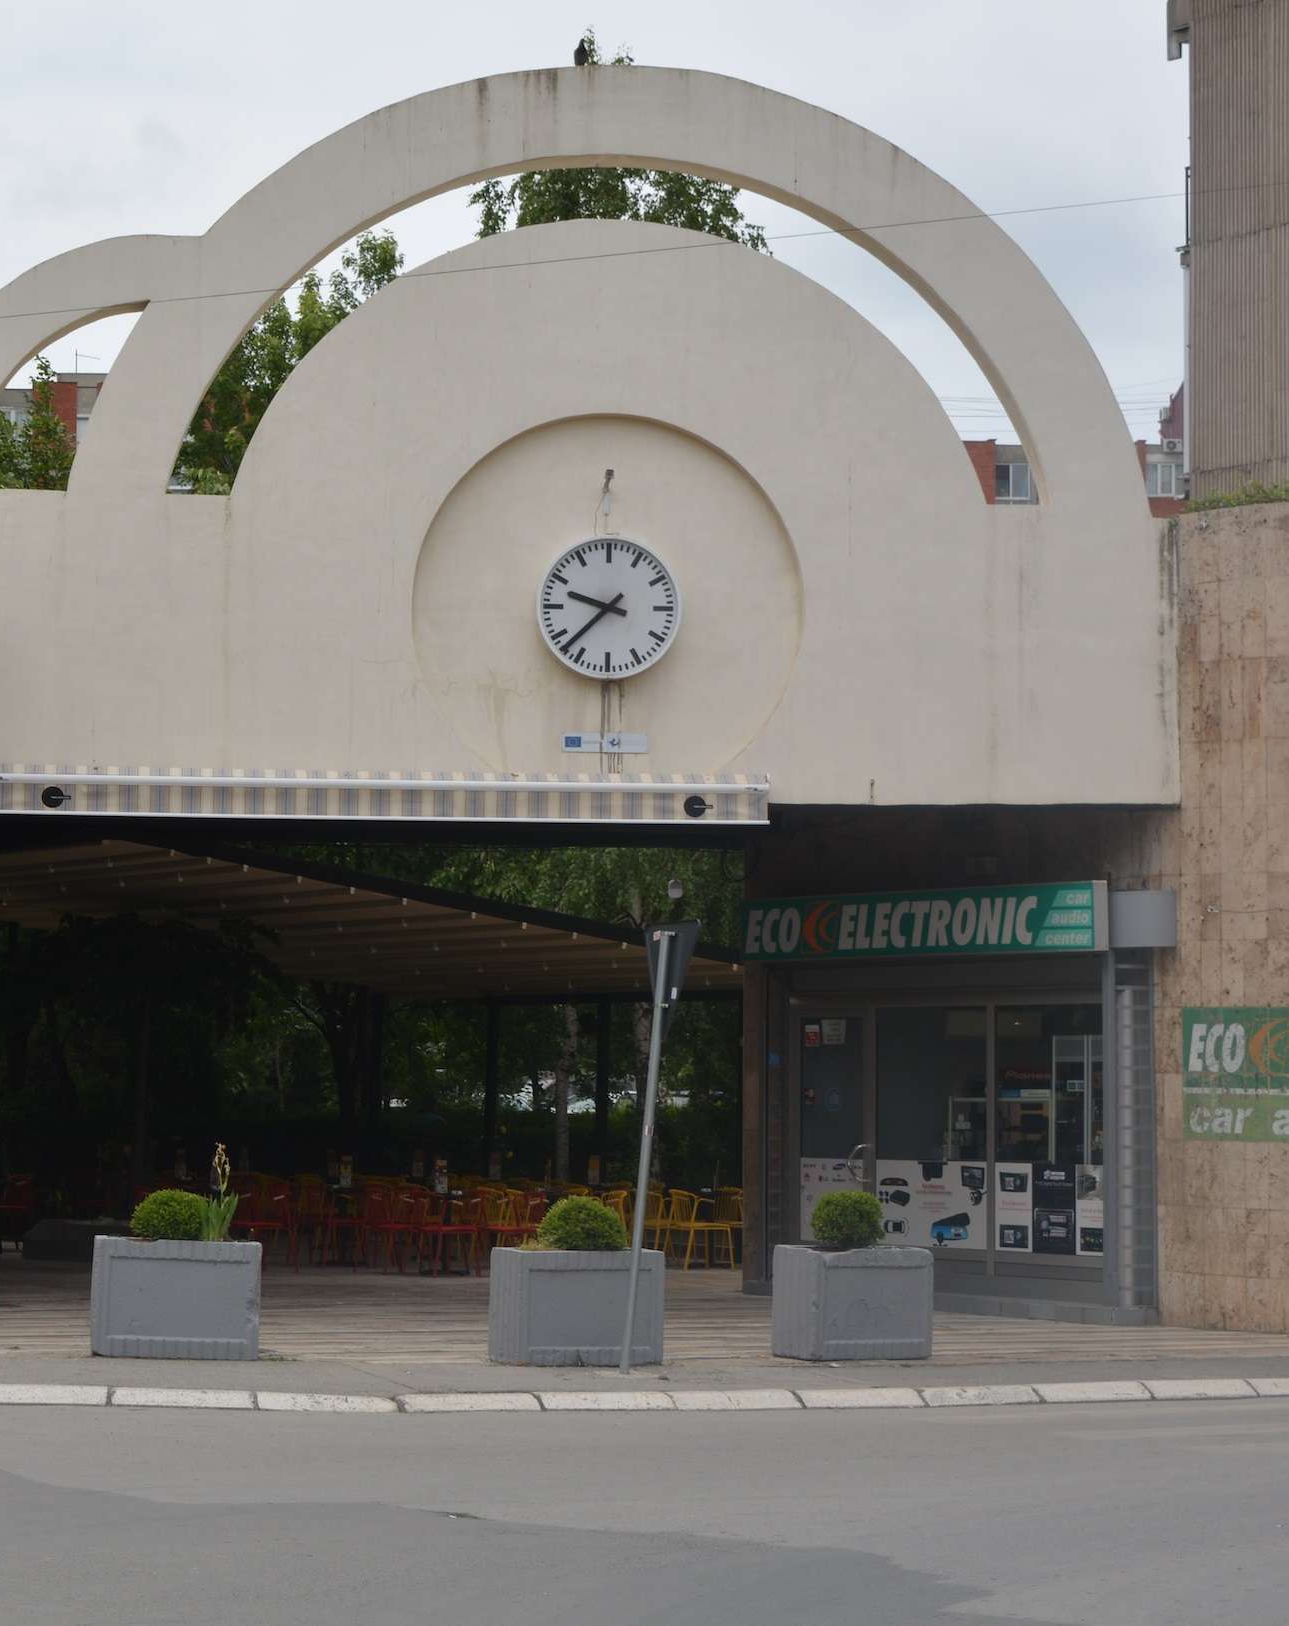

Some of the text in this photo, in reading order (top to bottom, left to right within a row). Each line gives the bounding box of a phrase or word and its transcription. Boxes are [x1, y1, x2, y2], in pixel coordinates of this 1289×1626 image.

[1065, 893, 1089, 906] car
[745, 895, 1038, 954] ECO ELECTRONIC
[1051, 910, 1089, 927] audio
[1044, 933, 1091, 948] center
[1188, 1022, 1245, 1074] ECO
[1189, 1105, 1255, 1135] car
